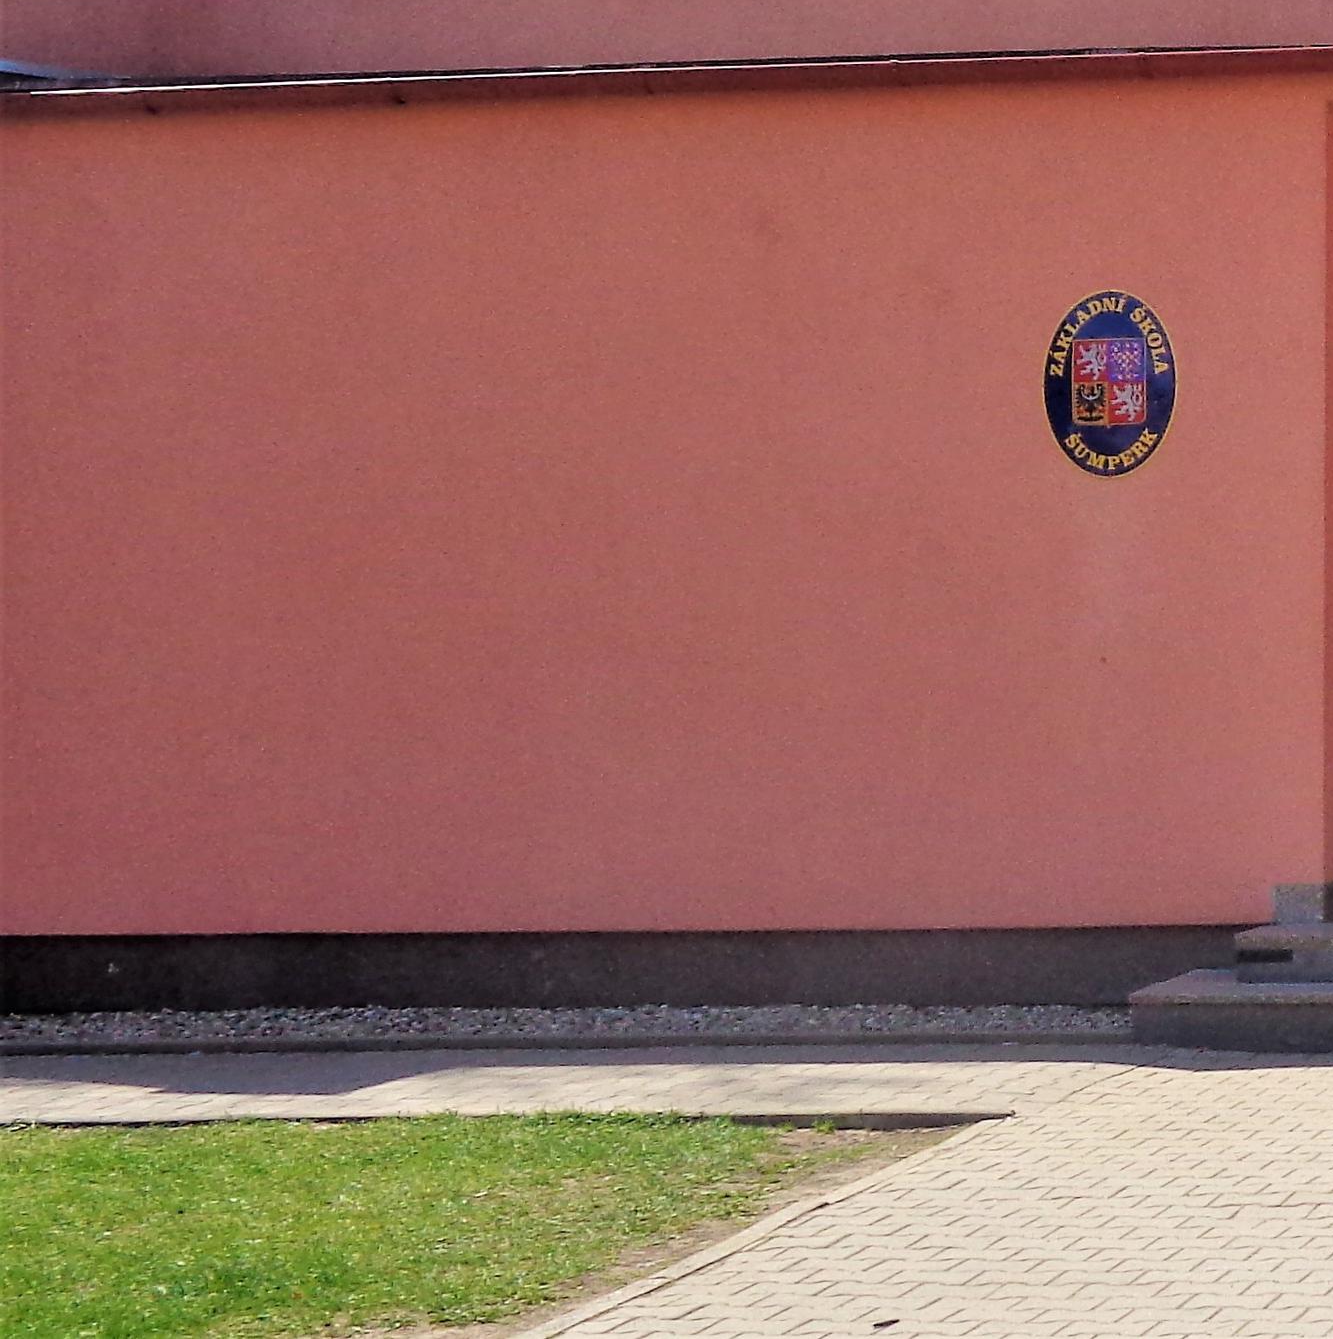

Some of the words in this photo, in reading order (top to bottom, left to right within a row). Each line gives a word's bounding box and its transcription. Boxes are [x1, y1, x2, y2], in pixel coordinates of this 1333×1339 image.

[1050, 295, 1127, 376] ZÁKLADNÍ
[1130, 305, 1169, 374] ŠKOLA
[1065, 428, 1158, 470] ŠUMPERK
